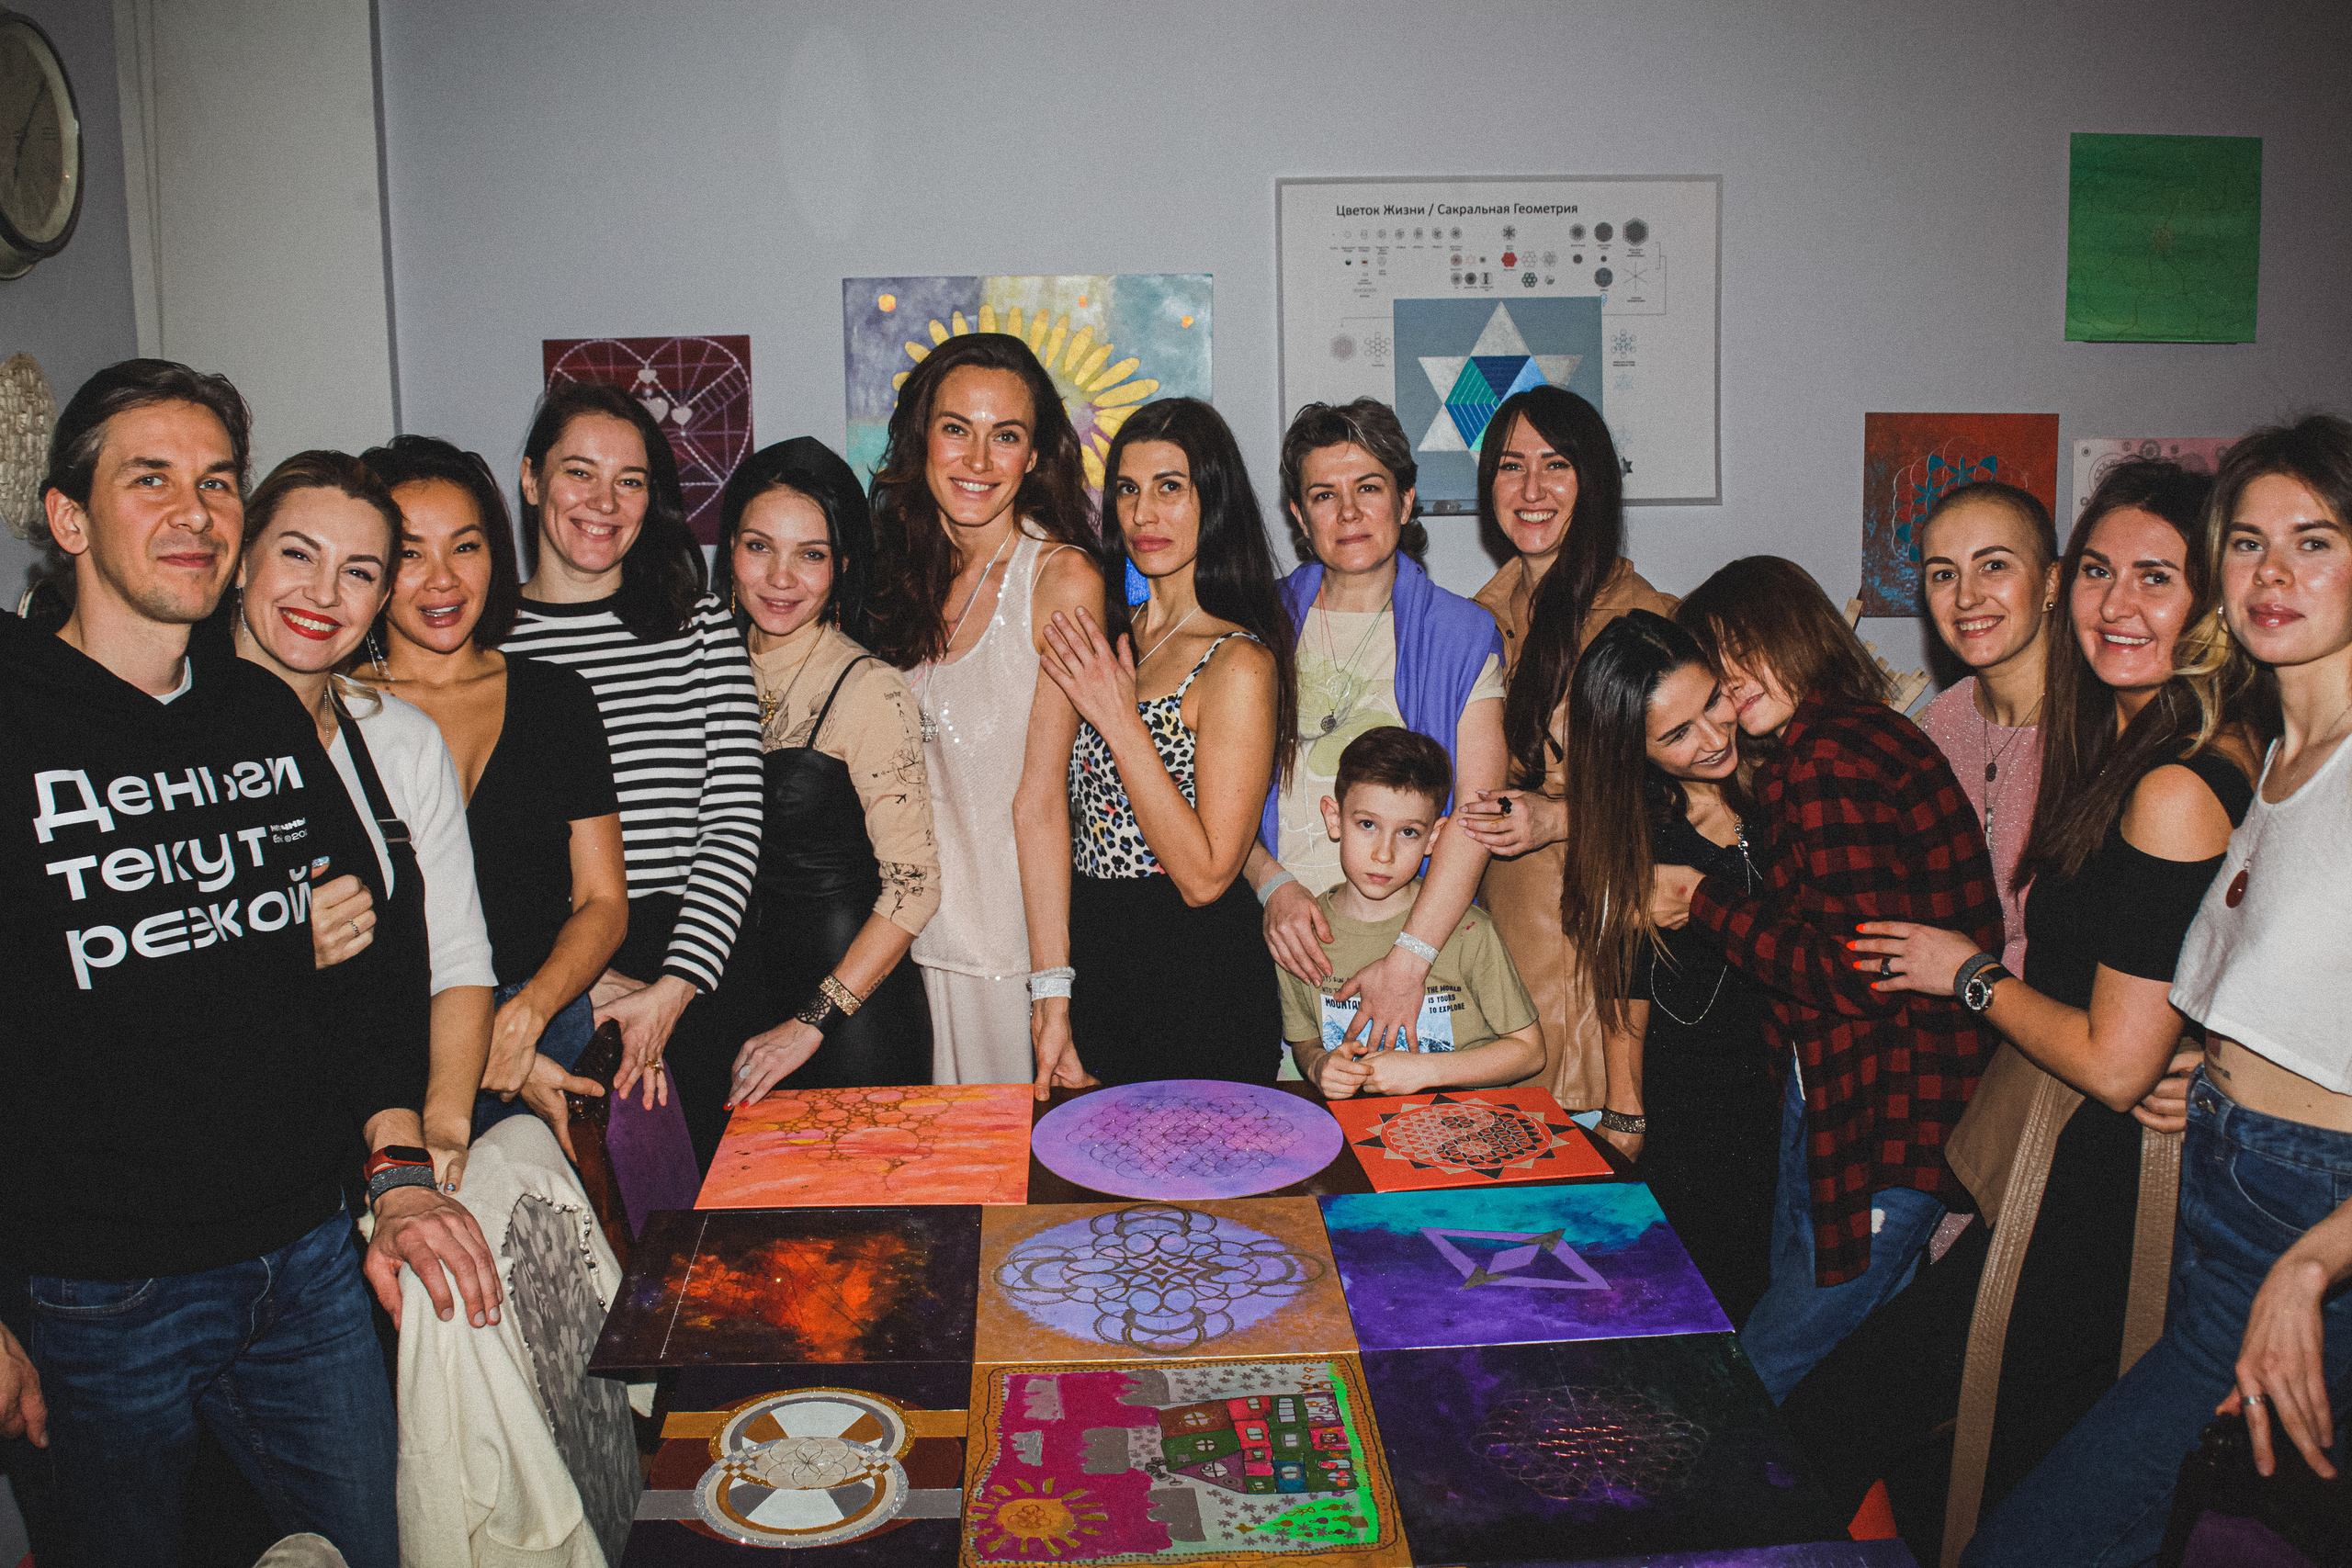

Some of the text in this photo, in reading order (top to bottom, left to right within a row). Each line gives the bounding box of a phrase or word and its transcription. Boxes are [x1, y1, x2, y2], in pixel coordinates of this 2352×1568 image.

[1335, 203, 1578, 218] Цветок Жизни / Сакральная Геометрия
[1427, 986, 1439, 994] THE
[1437, 994, 1456, 1003] YOURS
[1439, 1002, 1465, 1013] EXPLORE
